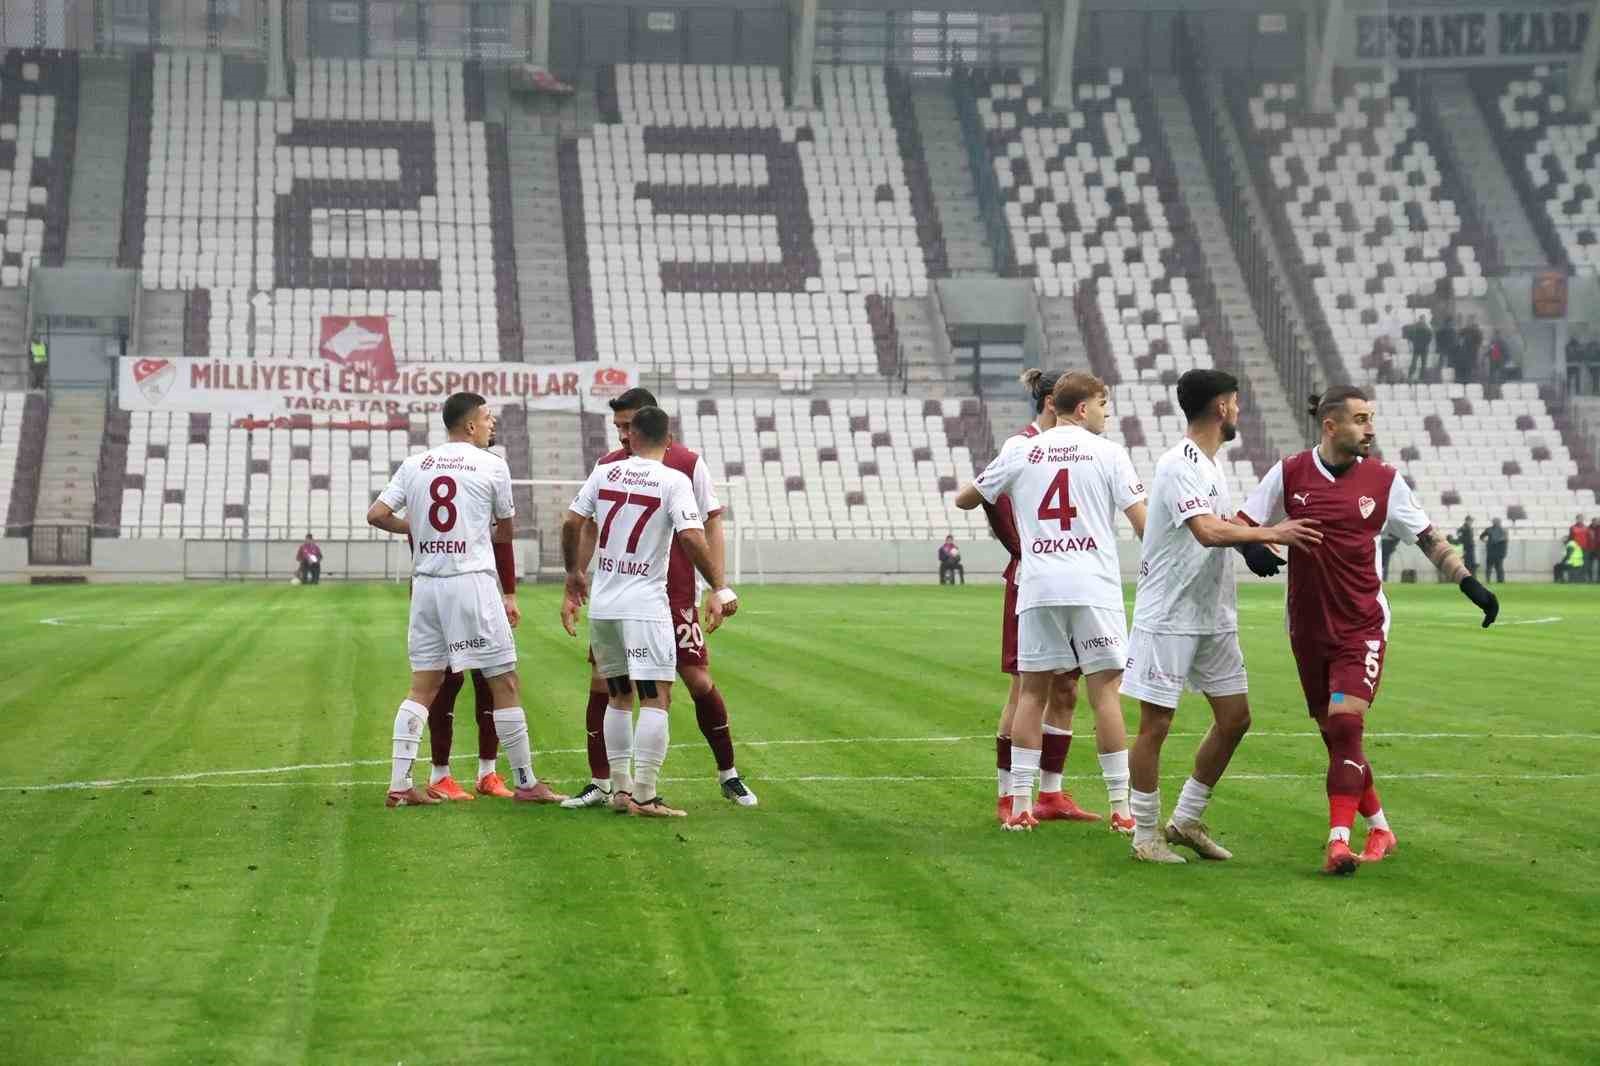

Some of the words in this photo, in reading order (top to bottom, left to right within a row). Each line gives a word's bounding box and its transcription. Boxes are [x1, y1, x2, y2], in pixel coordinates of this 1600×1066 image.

[190, 359, 331, 395] MİLLİYETÇİ
[283, 396, 400, 414] TARAFTAR
[428, 475, 457, 533] 8
[1037, 468, 1078, 532] 4
[598, 488, 662, 555] 77
[419, 541, 467, 554] KEREM
[1032, 536, 1098, 554] ÖZKAYA
[676, 622, 705, 649] 20
